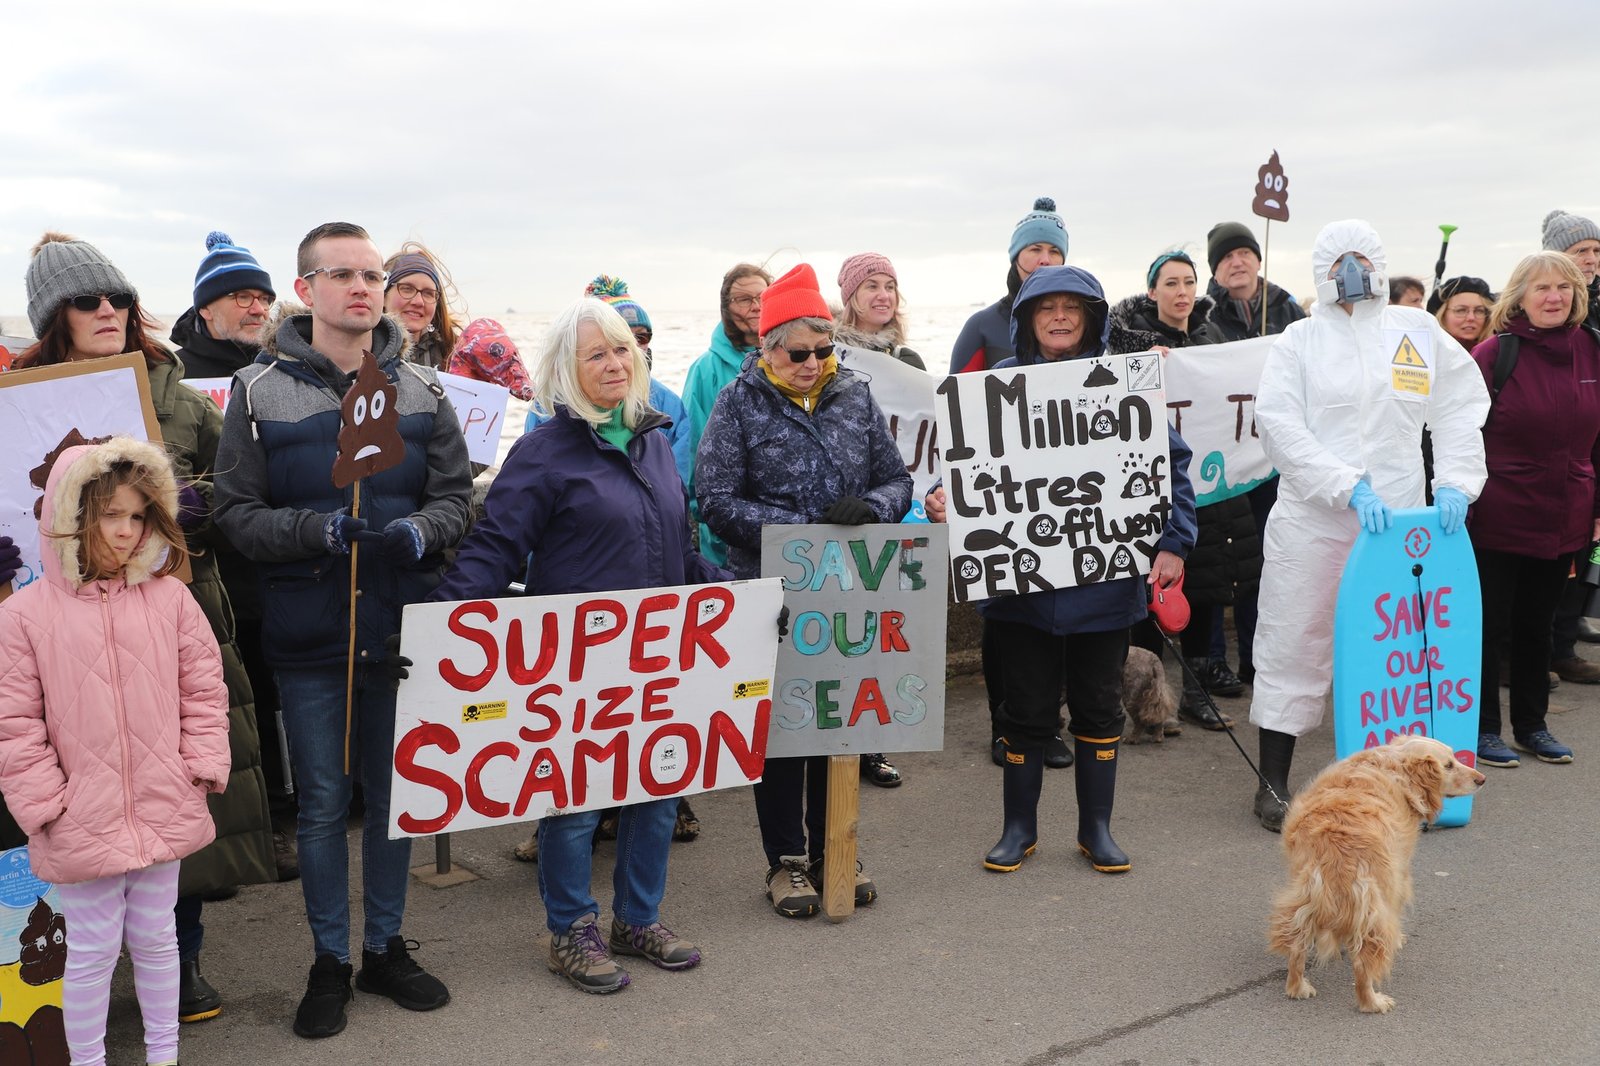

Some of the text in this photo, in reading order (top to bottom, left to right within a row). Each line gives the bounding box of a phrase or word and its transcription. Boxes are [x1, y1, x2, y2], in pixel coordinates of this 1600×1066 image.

[1394, 369, 1429, 380] WARNING
[936, 373, 1153, 462] 1 Million
[951, 464, 1106, 518] Litres
[1027, 496, 1173, 548] effluent
[782, 537, 929, 592] SAVE
[953, 547, 1055, 602] PER
[438, 586, 735, 692] SUPER
[792, 610, 911, 658] OUR
[1373, 587, 1452, 642] SAVE
[1386, 646, 1445, 678] OUR
[479, 702, 506, 710] WARNING
[775, 673, 928, 731] SEAS
[1361, 678, 1474, 728] RIVERS
[394, 698, 772, 834] SCAMON
[660, 764, 677, 772] TOXIC
